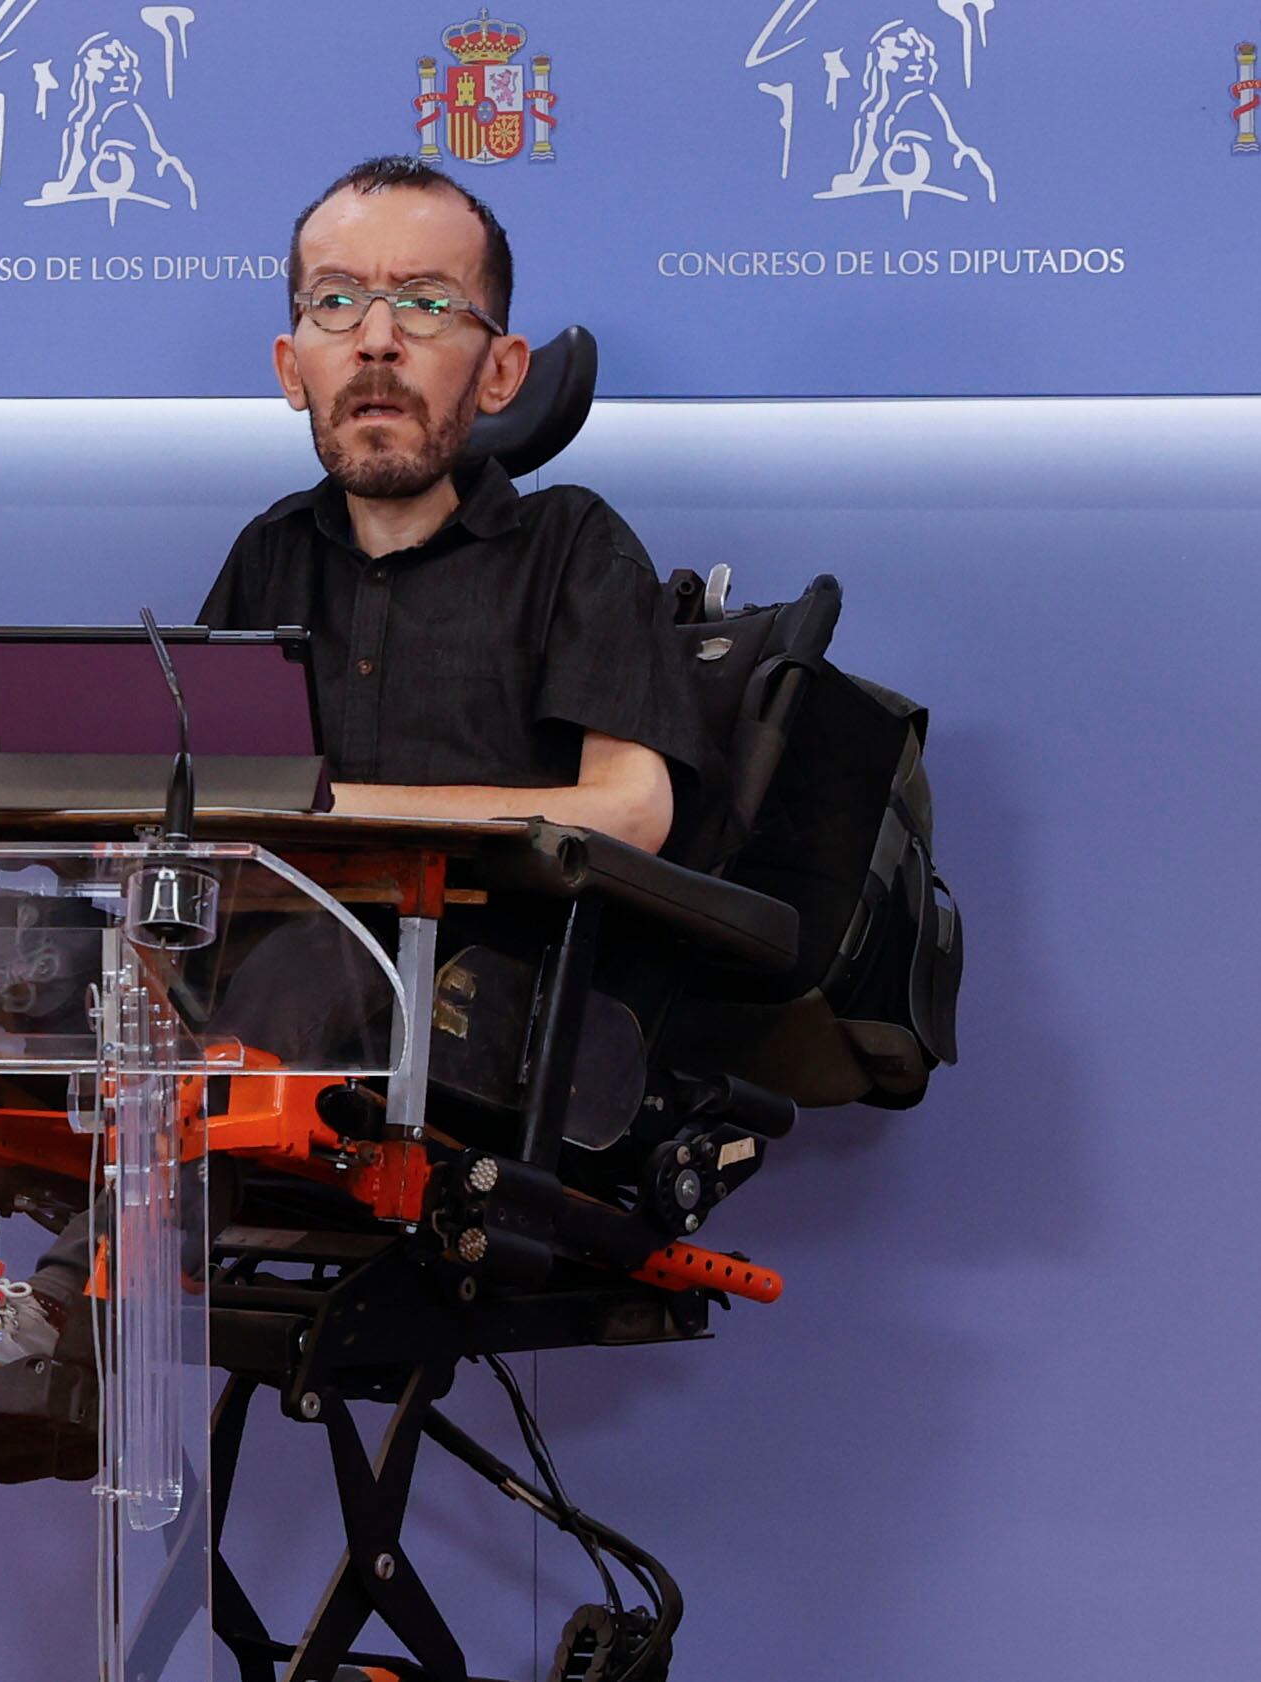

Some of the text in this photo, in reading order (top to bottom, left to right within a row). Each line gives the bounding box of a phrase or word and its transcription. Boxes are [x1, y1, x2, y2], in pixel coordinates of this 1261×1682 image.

[46, 256, 82, 281] DE
[92, 256, 144, 281] LOS
[657, 248, 1126, 277] CONGRESO DE LOS DIPUTADOS
